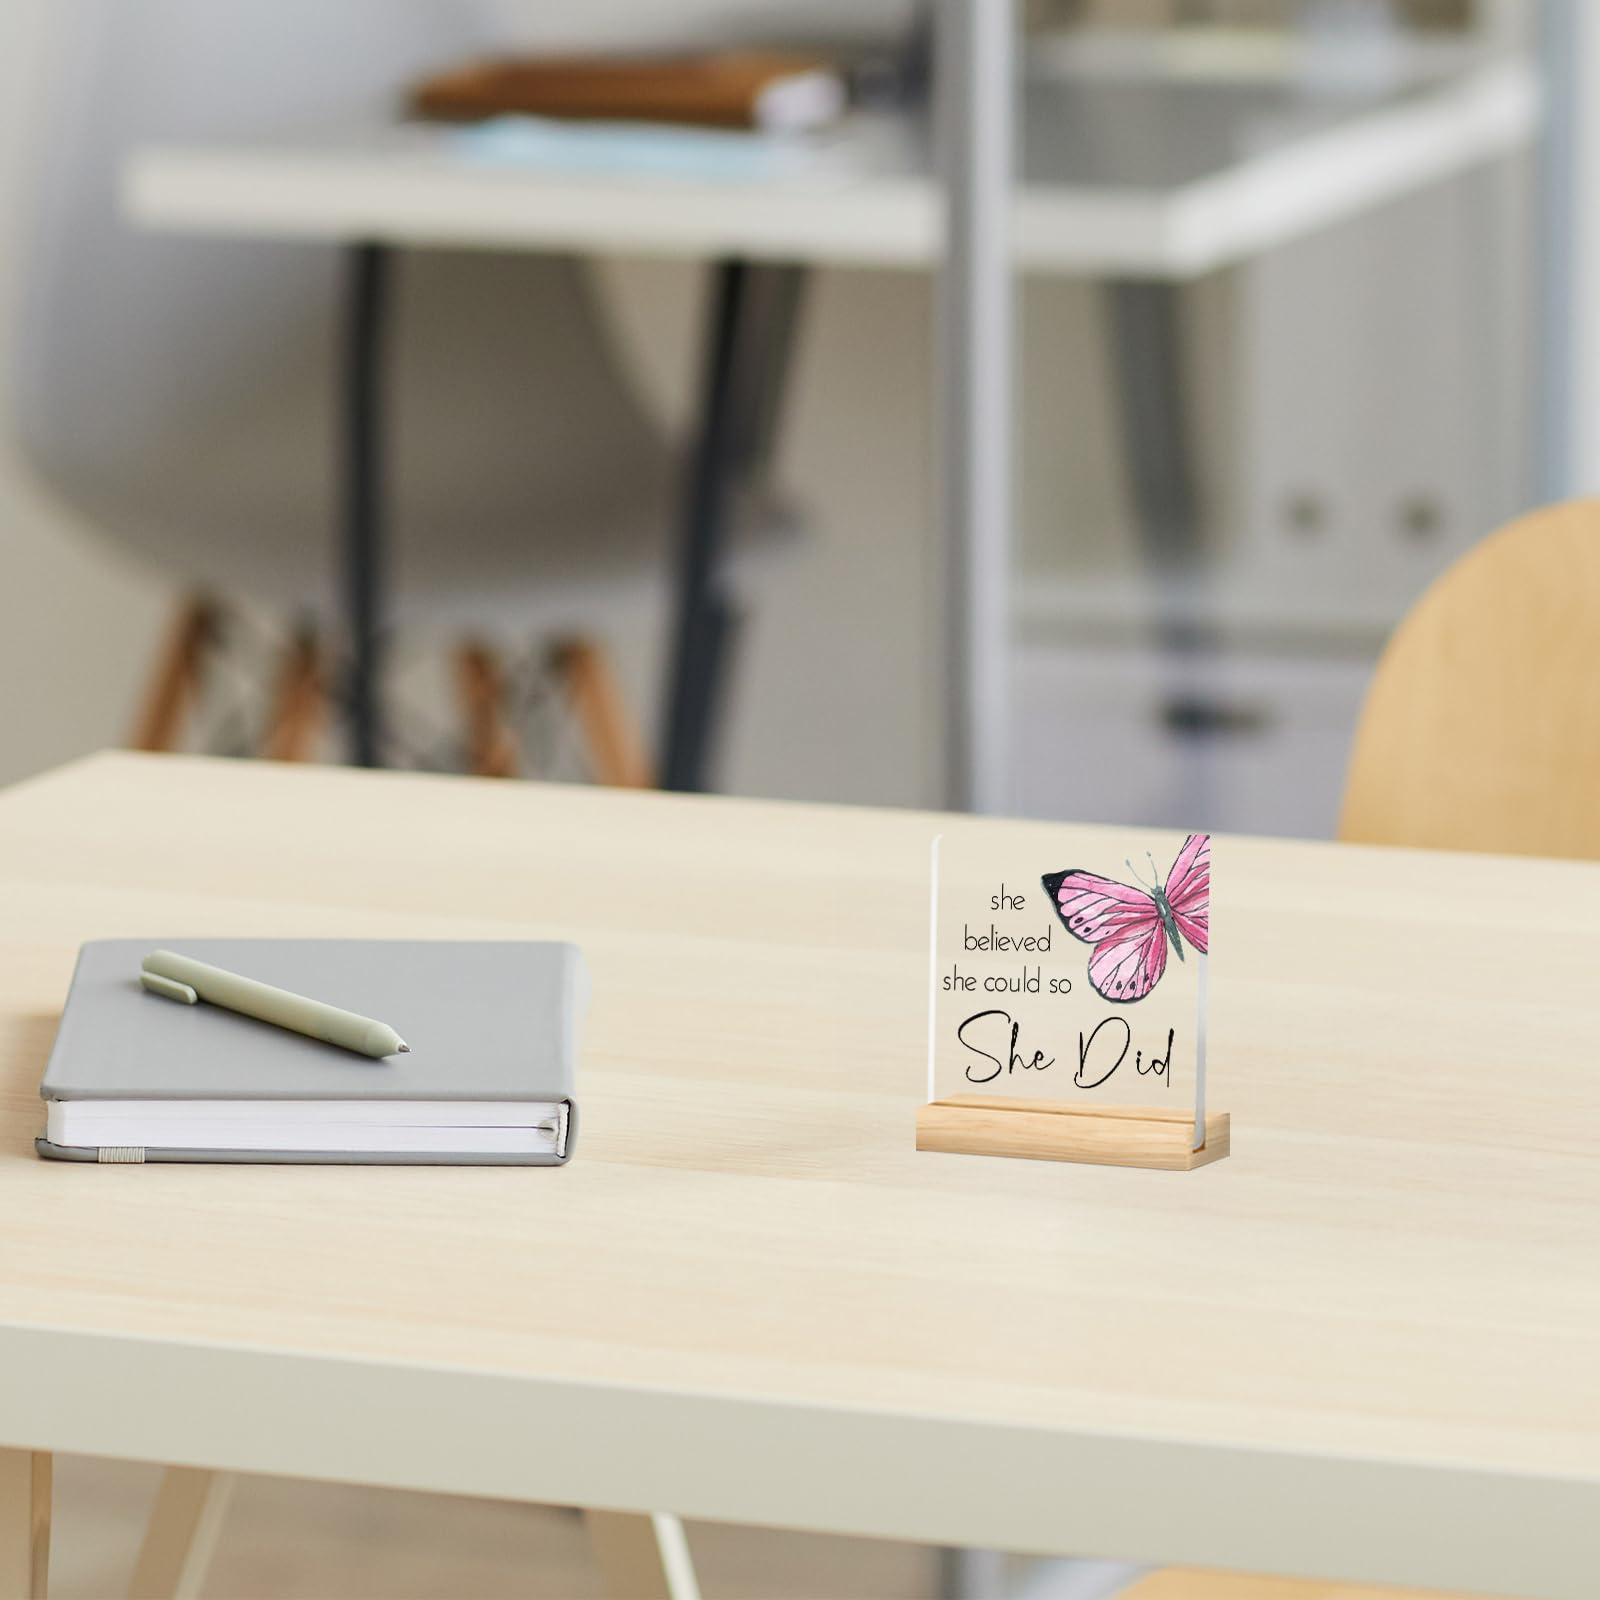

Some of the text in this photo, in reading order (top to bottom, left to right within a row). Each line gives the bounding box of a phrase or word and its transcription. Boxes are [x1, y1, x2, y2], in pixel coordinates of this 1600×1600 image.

[990, 883, 1026, 911] she
[964, 923, 1052, 952] believed
[942, 964, 1073, 994] she could so
[957, 1009, 1175, 1089] She Did
